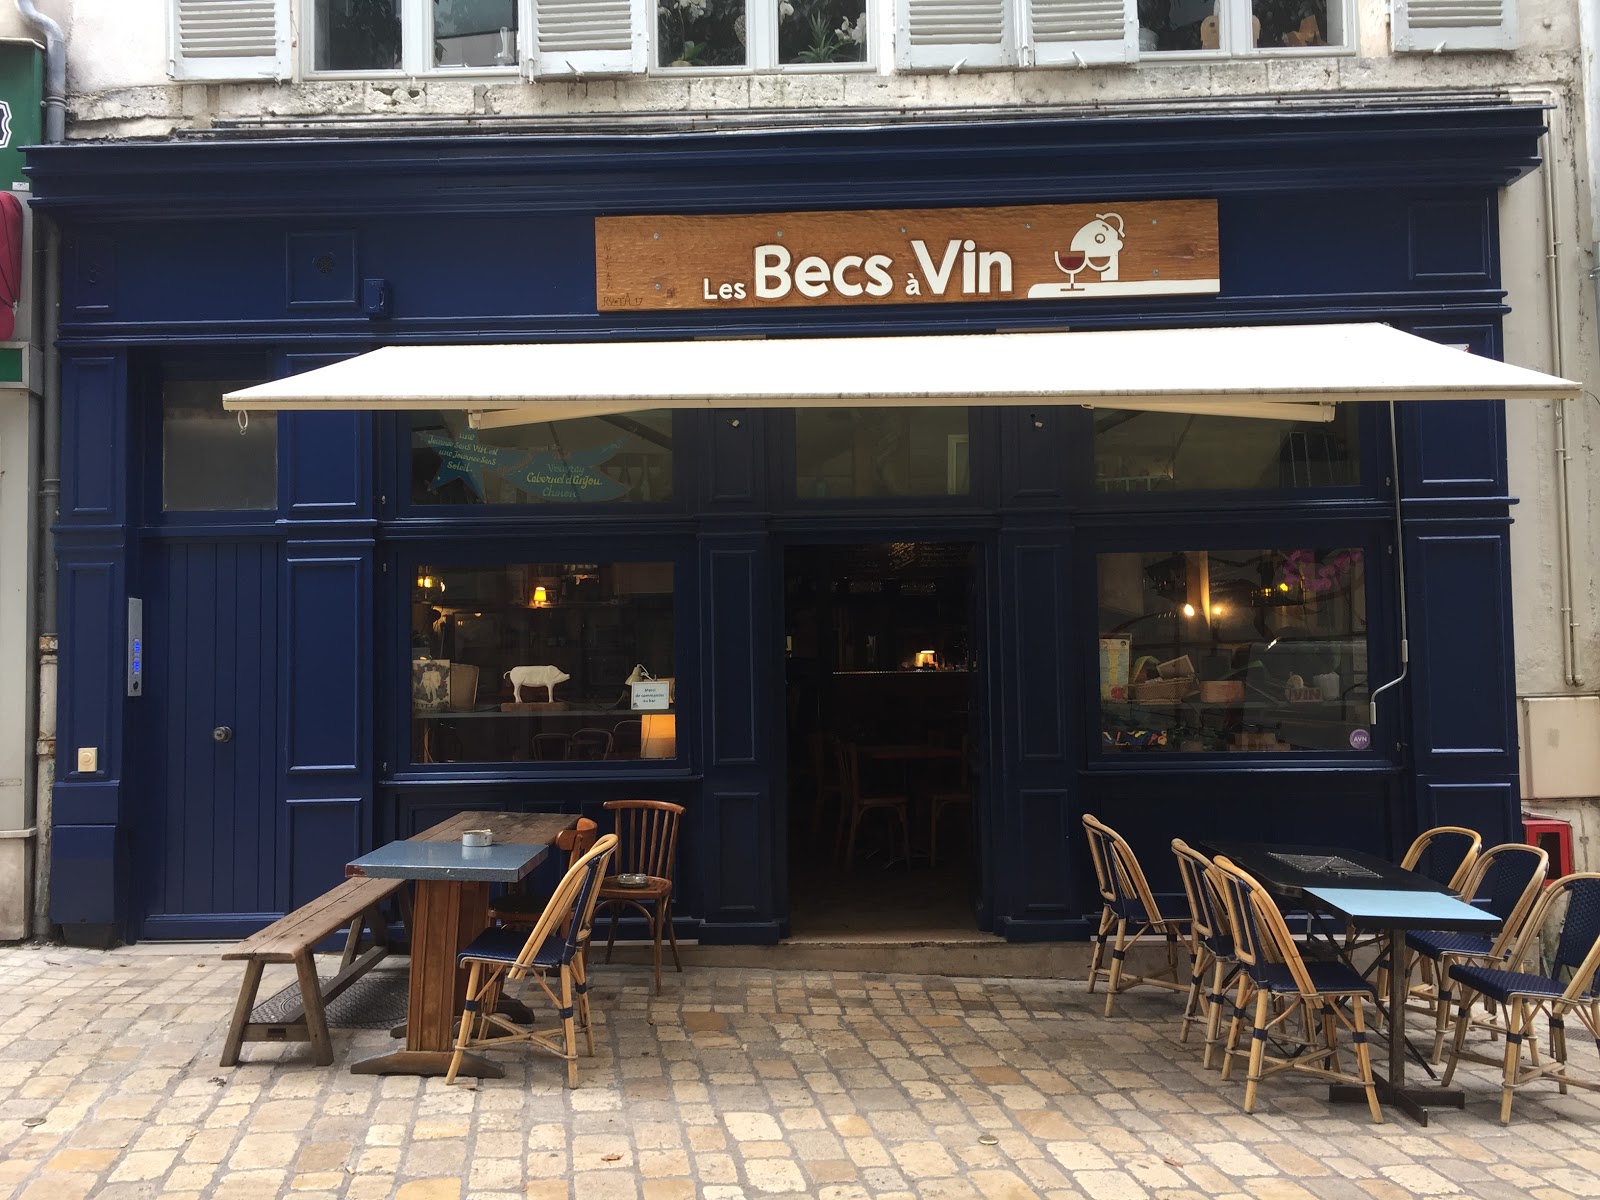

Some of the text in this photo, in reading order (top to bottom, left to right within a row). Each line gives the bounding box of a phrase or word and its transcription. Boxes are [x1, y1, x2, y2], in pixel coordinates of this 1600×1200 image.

[703, 239, 1012, 300] Les Becs à Vin
[546, 464, 585, 476] Vouvray
[526, 471, 565, 484] Cabernet
[542, 485, 577, 498] Chinon
